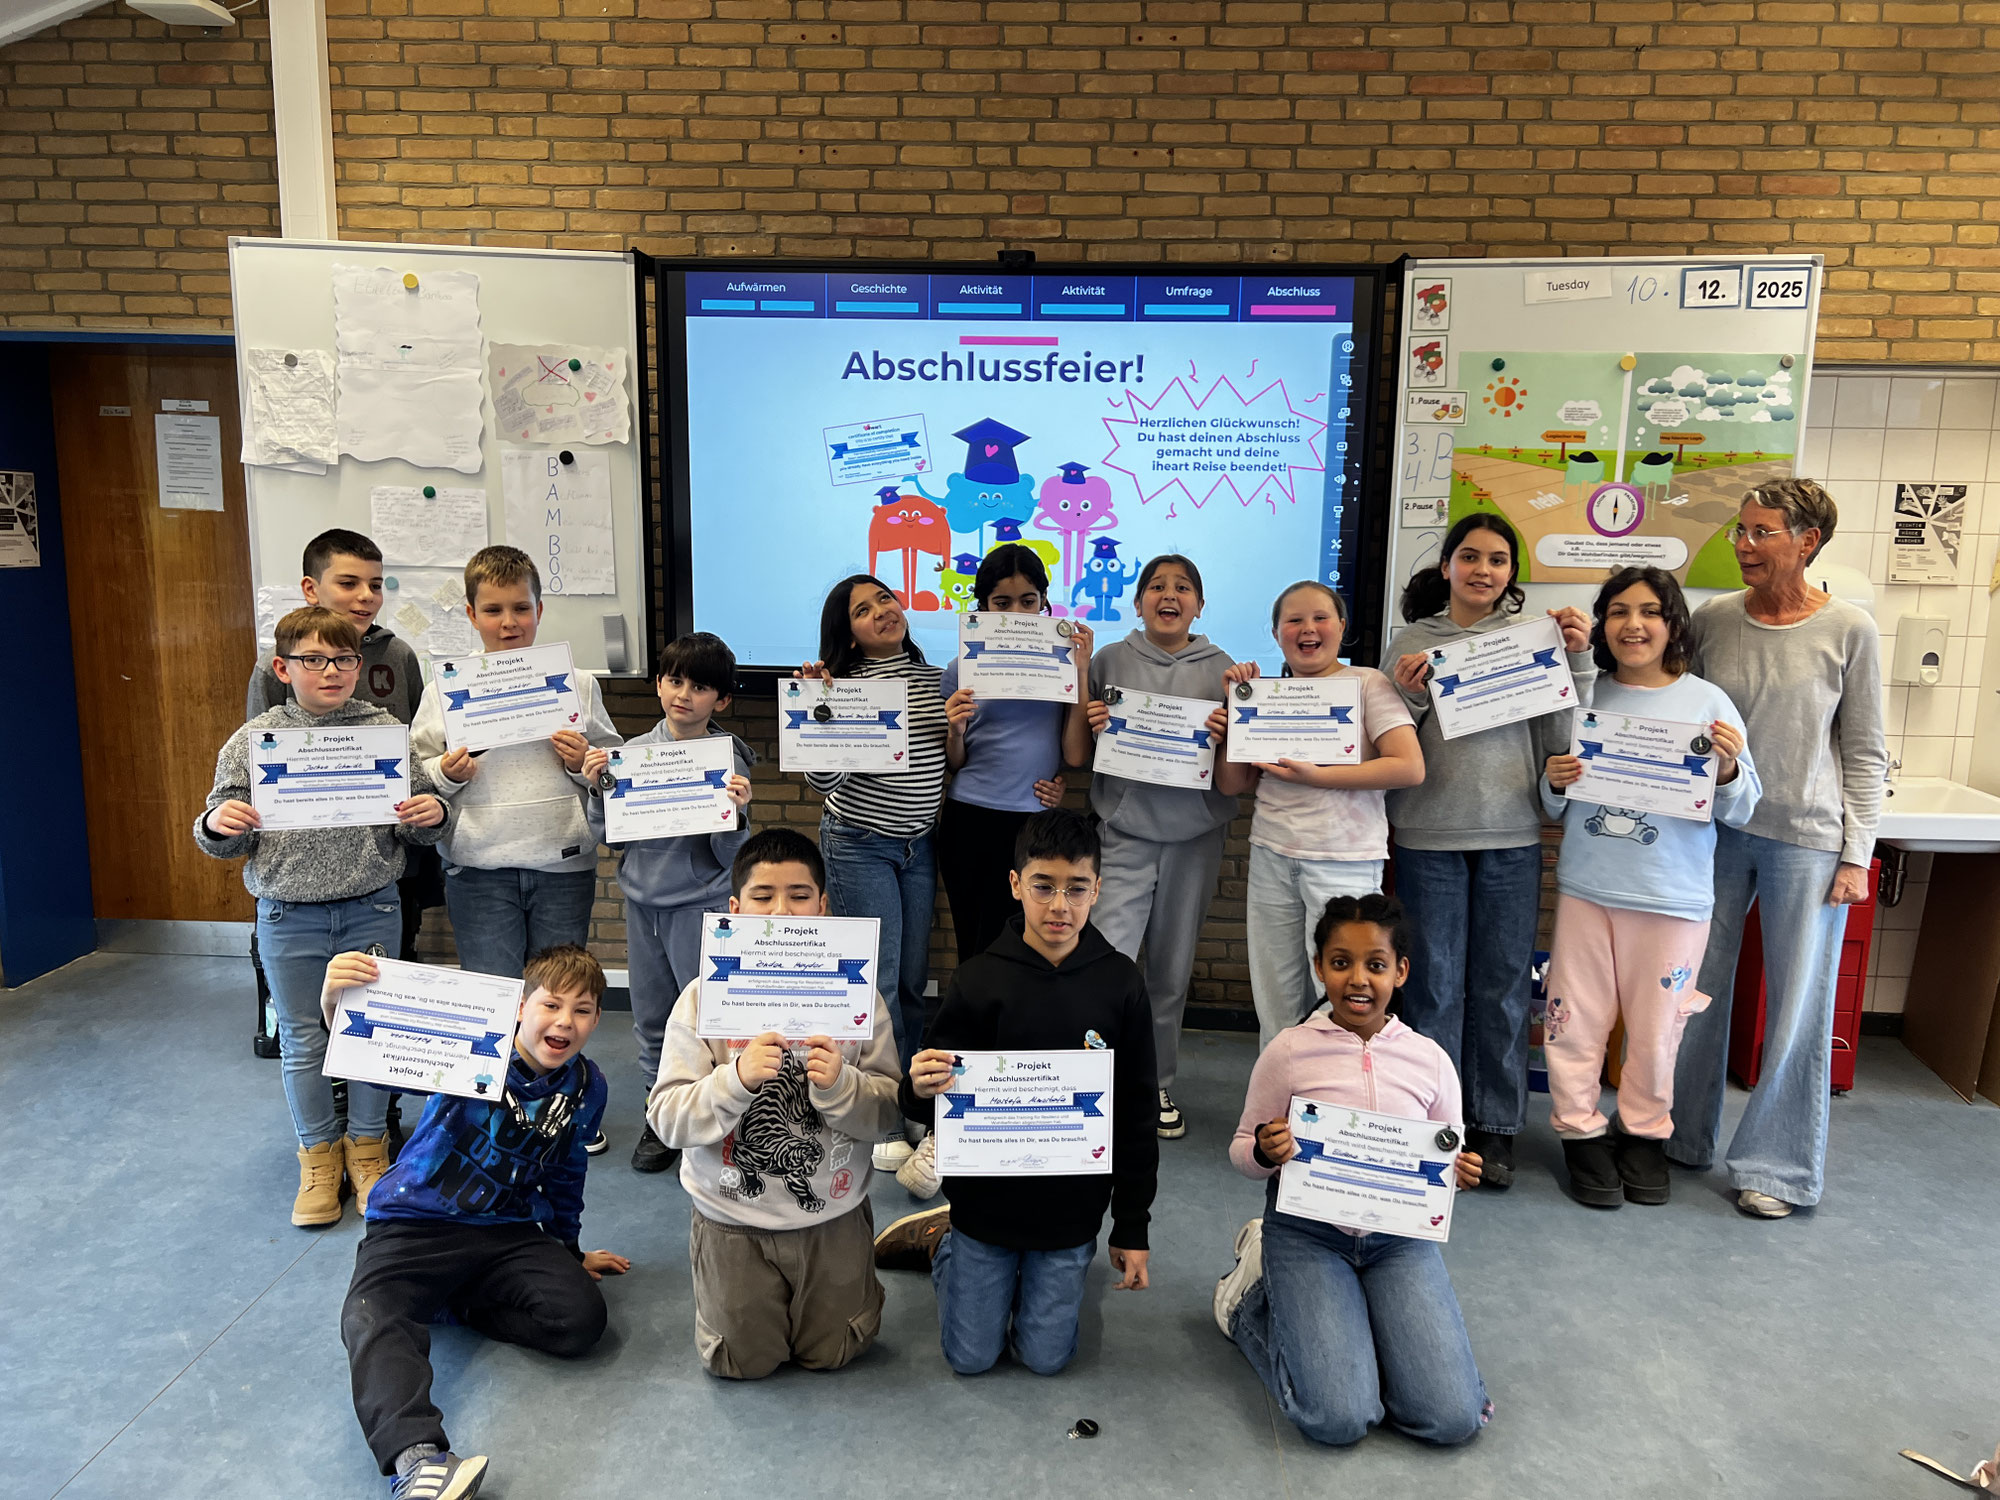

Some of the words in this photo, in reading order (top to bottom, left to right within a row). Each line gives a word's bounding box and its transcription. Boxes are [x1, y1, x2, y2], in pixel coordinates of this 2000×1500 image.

[726, 282, 786, 293] Aufwärmen
[851, 284, 907, 294] Geschichte
[959, 285, 1003, 295] Aktivität
[1062, 286, 1105, 296] Aktivität
[1267, 286, 1320, 296] Abschluss
[1546, 279, 1590, 292] Tuesday
[1627, 275, 1669, 304] 10.
[1698, 279, 1726, 300] 12.
[1757, 280, 1804, 299] 2025
[1166, 286, 1212, 297] Umfrage
[841, 350, 1144, 383] Abschlussfeier!
[1140, 418, 1206, 429] Herzlichen
[1210, 418, 1300, 430] Glückwunsch!
[1138, 433, 1155, 443] Du
[1159, 432, 1186, 443] hast
[1189, 432, 1232, 443] deinen
[1236, 432, 1300, 443] Abschluss
[1156, 448, 1212, 459] gemacht
[1217, 447, 1240, 458] und
[1244, 447, 1280, 458] deine
[1152, 461, 1189, 472] iheart
[1193, 462, 1227, 472] Reise
[1230, 461, 1287, 472] beendet!
[1528, 490, 1565, 510] nein
[1483, 636, 1510, 648] Projekt
[497, 657, 524, 666] Projekt
[373, 670, 391, 690] K
[1159, 703, 1182, 711] Projekt
[1639, 725, 1668, 734] Projekt
[784, 927, 818, 936] Projekt
[436, 999, 450, 1007] alles
[451, 1001, 471, 1010] bereits
[426, 1048, 442, 1056] wird
[443, 1050, 469, 1060] Hiermit
[382, 1053, 454, 1069] Abschlusszertifikat
[1017, 1062, 1051, 1071] Projekt
[388, 1066, 423, 1077] Projekt
[1019, 1085, 1060, 1093] bescheinigt,
[1369, 1122, 1402, 1134] Projekt
[1339, 1129, 1409, 1147] Abschlusszertifikat
[1351, 1141, 1366, 1150] wird
